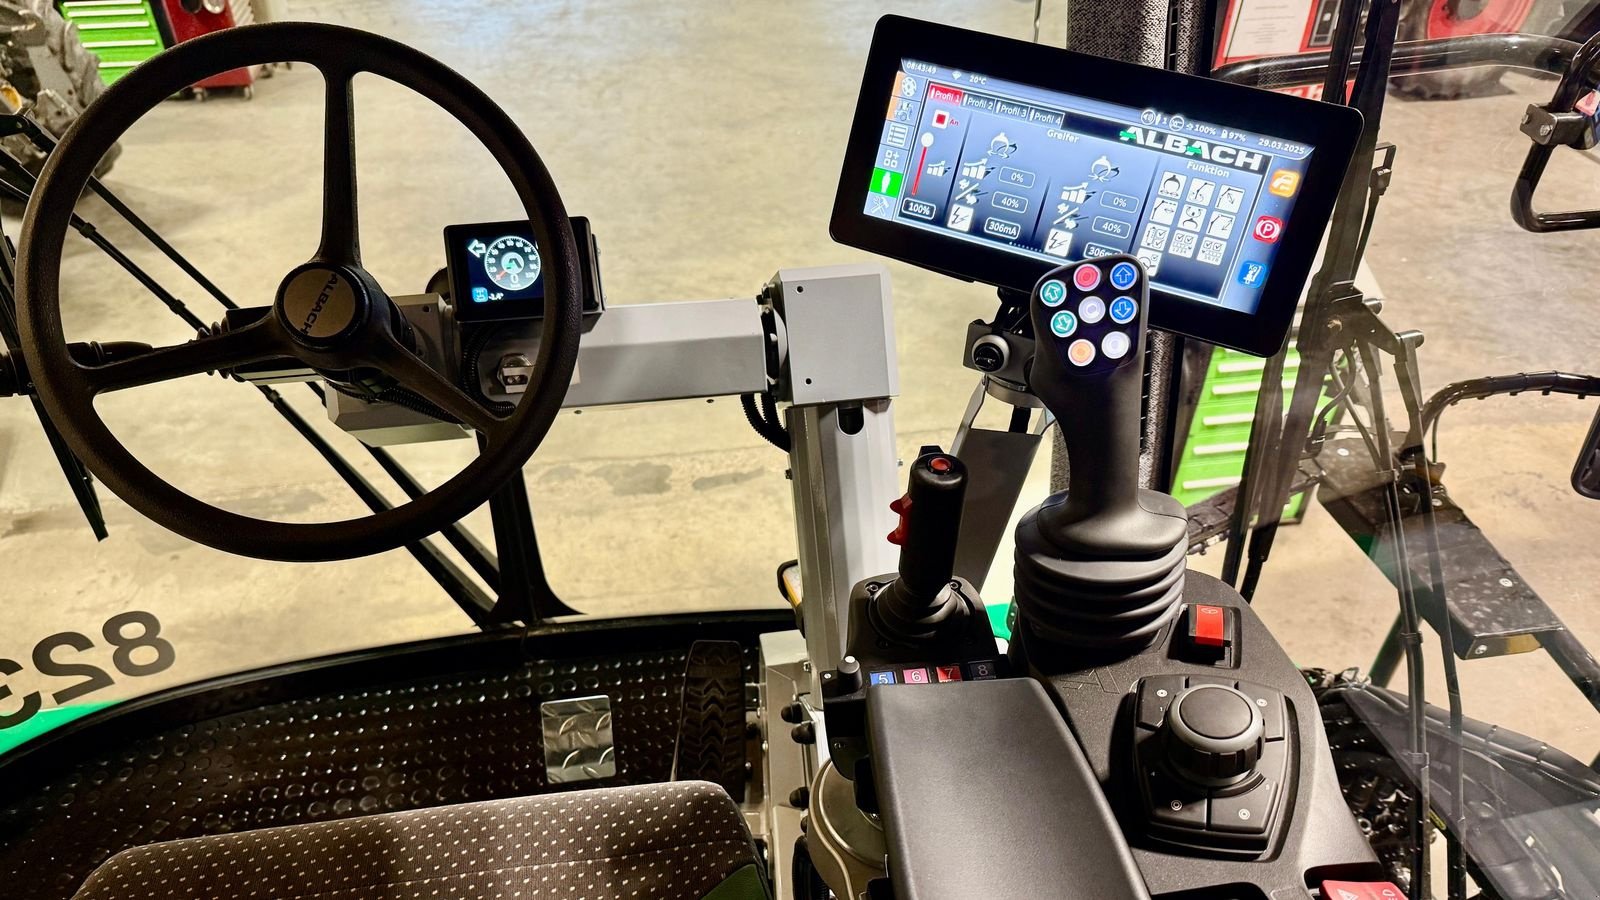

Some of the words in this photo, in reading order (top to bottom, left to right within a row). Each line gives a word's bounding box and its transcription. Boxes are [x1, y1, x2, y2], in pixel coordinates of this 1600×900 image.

[906, 61, 937, 74] 08:43:49
[935, 90, 953, 102] Profil
[967, 97, 987, 109] Profil
[1001, 104, 1020, 116] Profil
[1034, 112, 1054, 124] Profil
[1047, 129, 1080, 143] Greifer
[1194, 124, 1216, 136] 100%
[1229, 131, 1247, 142] 97%
[1119, 126, 1263, 171] ALBACH
[1258, 138, 1305, 154] 29.03.2025
[1187, 161, 1230, 178] Funktion
[1010, 172, 1024, 183] 0%
[1001, 196, 1019, 209] 40%
[1113, 196, 1127, 208] 0%
[908, 202, 930, 215] 100%
[988, 221, 1018, 236] 306mA
[1102, 221, 1122, 234] 40%
[1263, 224, 1272, 234] P
[511, 274, 519, 283] 0
[300, 273, 338, 336] ALBACH
[945, 668, 953, 679] 7
[978, 664, 988, 676] 8
[879, 674, 888, 684] 5
[911, 671, 921, 682] 6
